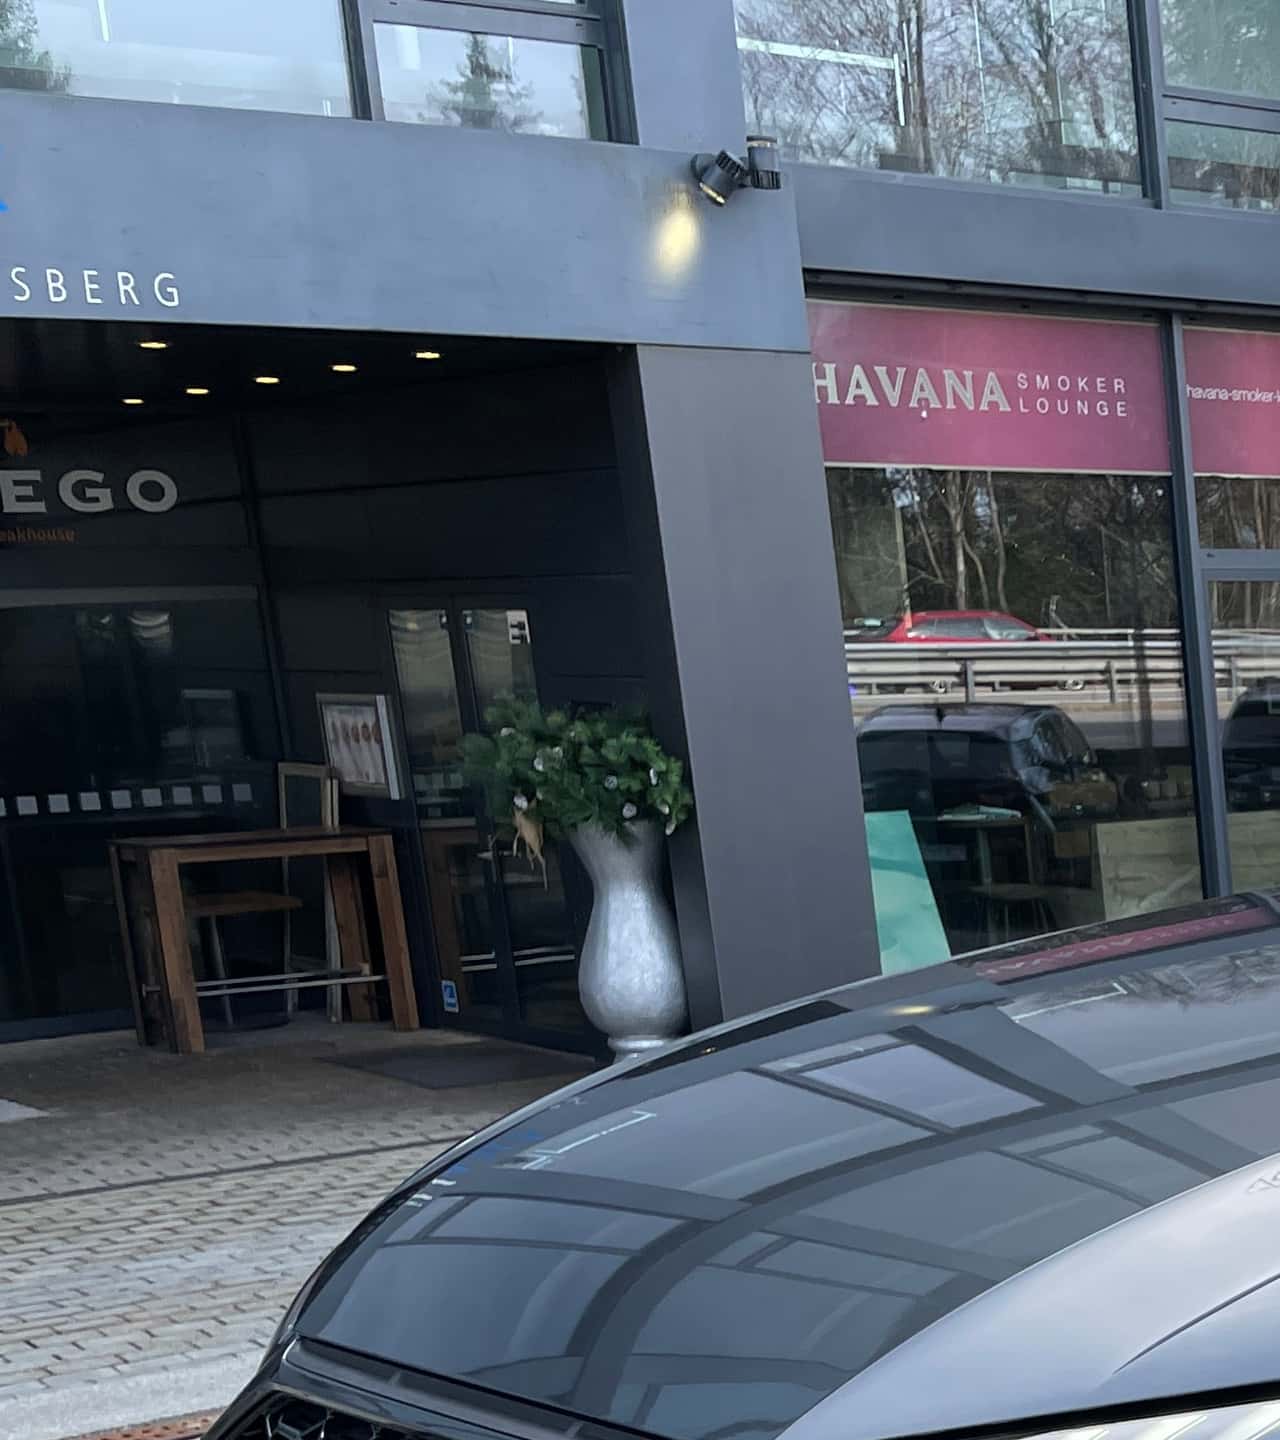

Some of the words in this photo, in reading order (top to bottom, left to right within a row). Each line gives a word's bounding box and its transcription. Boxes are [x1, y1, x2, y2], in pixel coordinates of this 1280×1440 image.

[11, 266, 179, 307] SBERG
[812, 363, 1012, 411] HAVANA
[1017, 373, 1126, 393] SMOKER
[1018, 398, 1128, 417] LOUNGE
[0, 469, 178, 513] EGO
